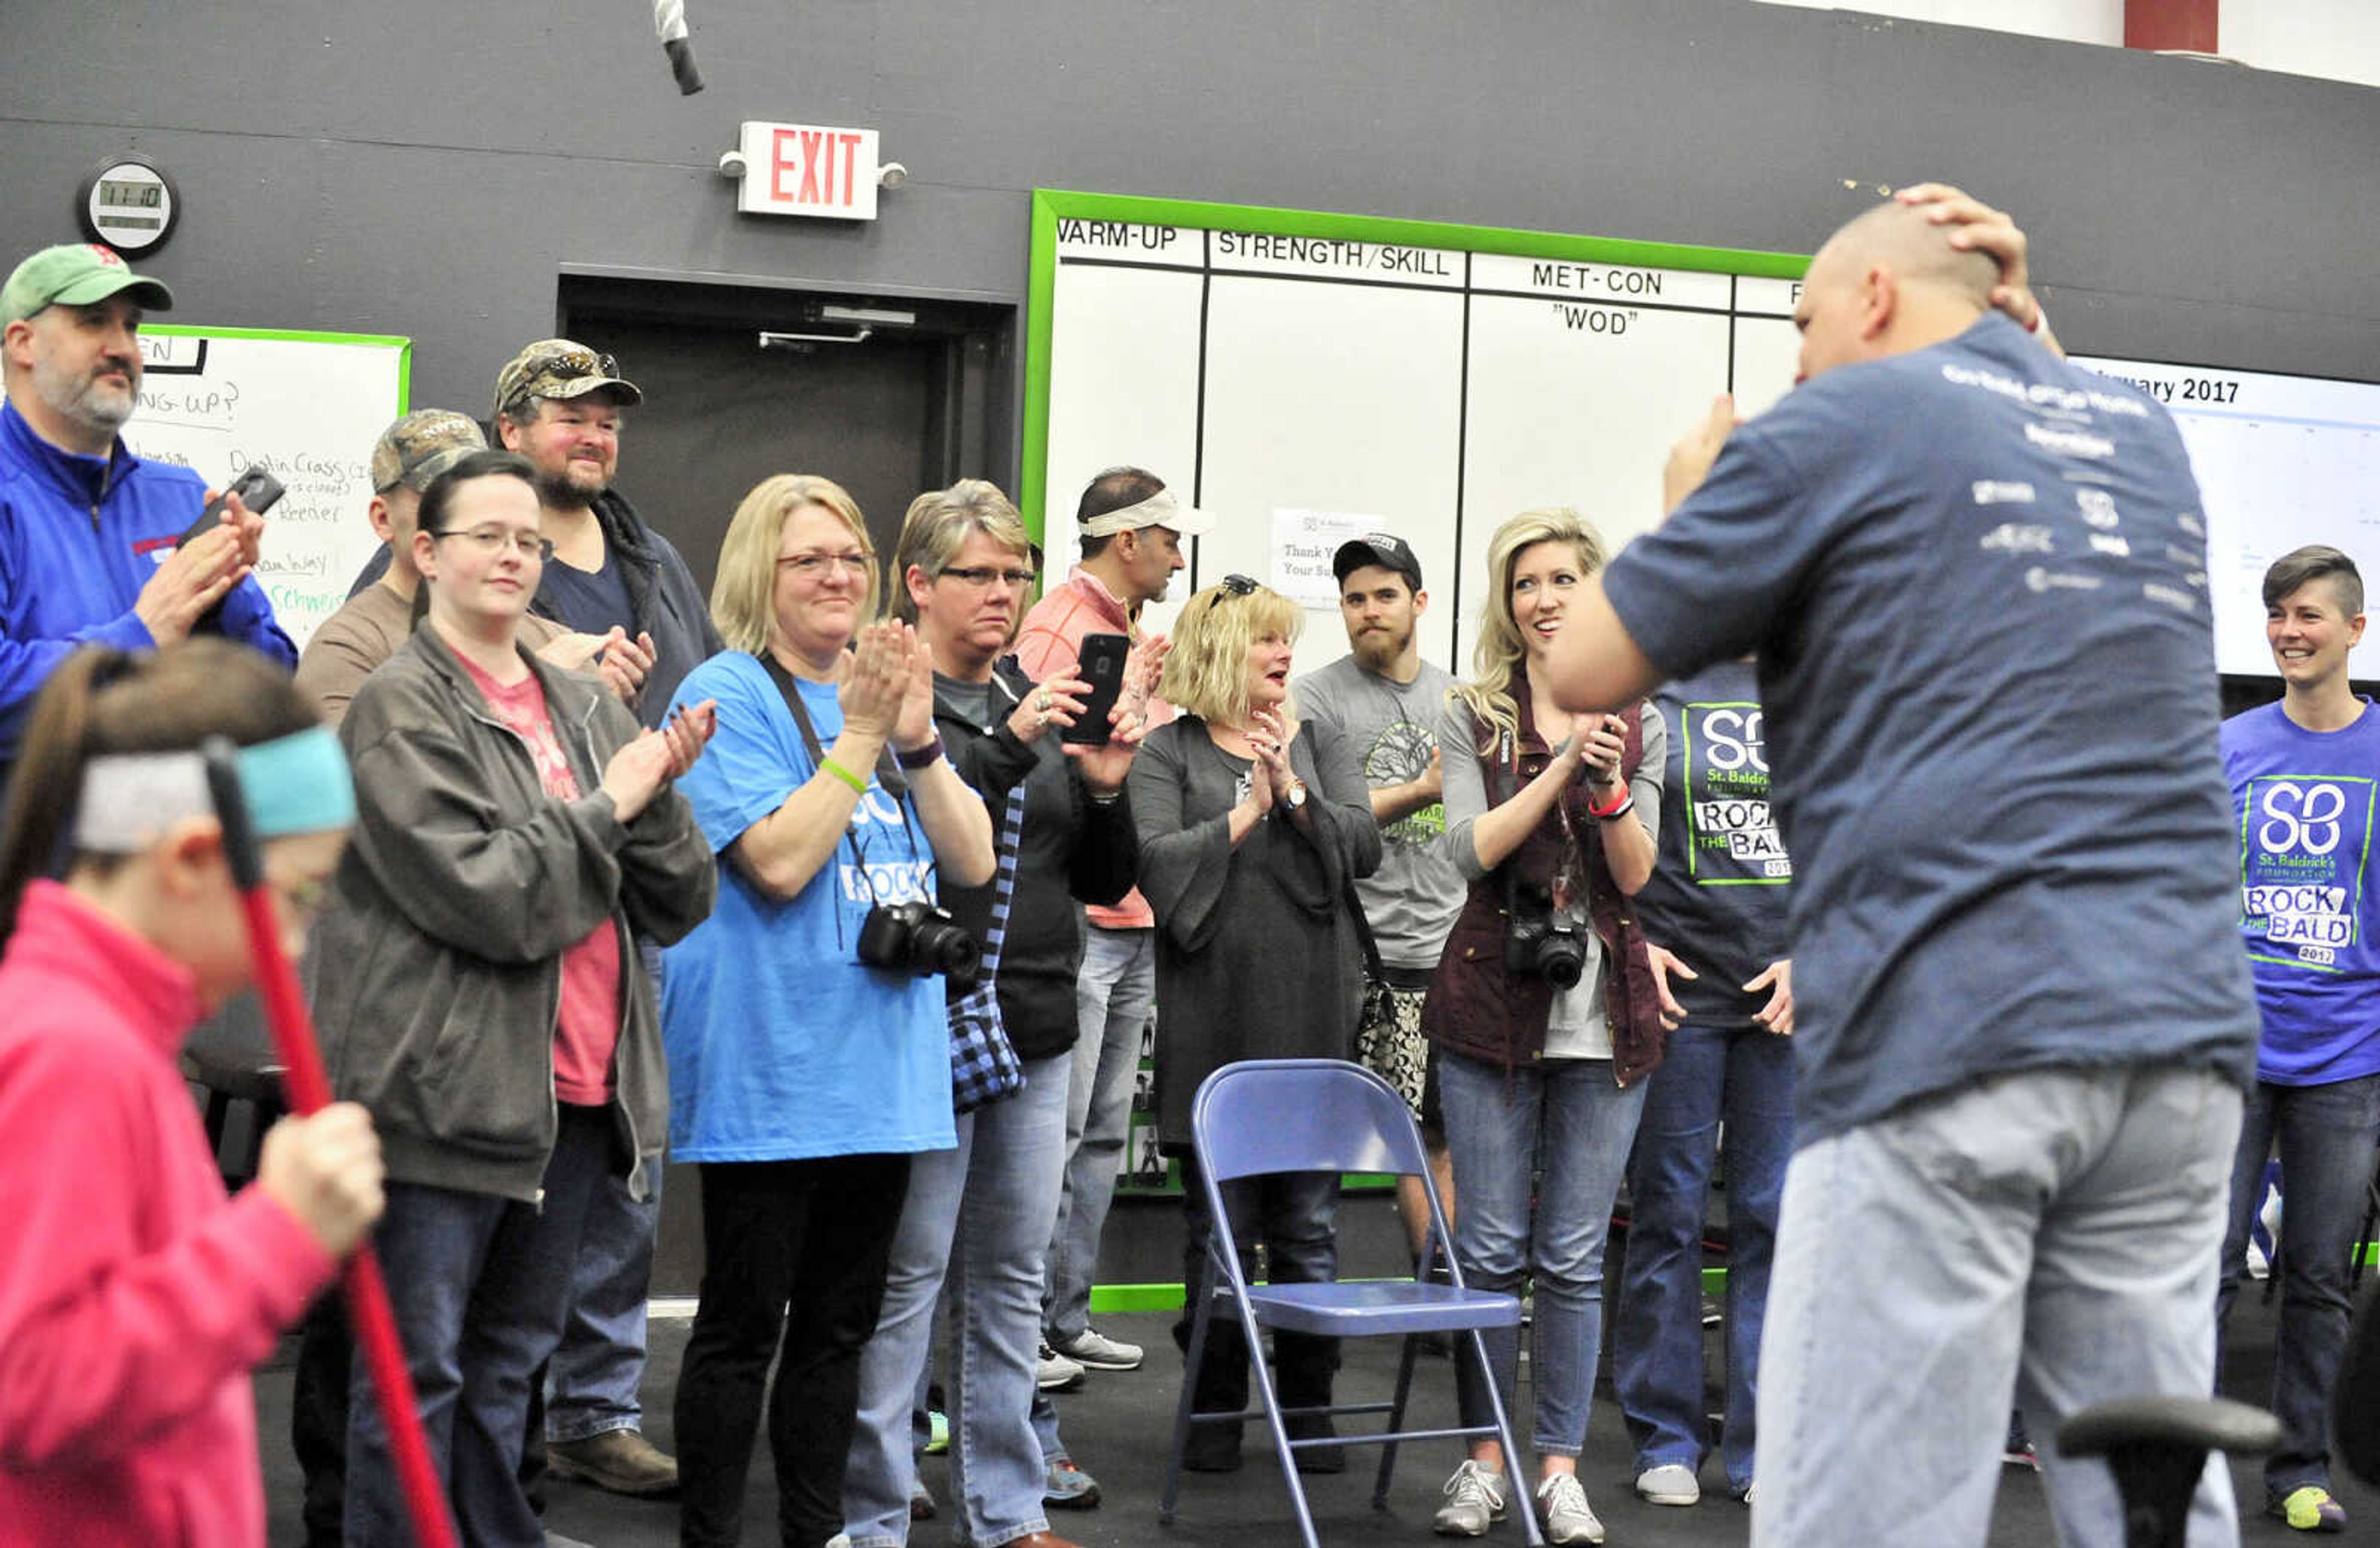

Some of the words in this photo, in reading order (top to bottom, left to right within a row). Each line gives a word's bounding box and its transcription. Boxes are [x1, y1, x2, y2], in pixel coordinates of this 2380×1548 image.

[771, 128, 862, 207] EXIT
[1219, 231, 1450, 276] STRENGTH/SKILL
[1533, 264, 1662, 295] MET-CON
[1553, 304, 1638, 335] "WOD"
[2182, 379, 2239, 403] 2017
[1285, 544, 1322, 559] Thank
[1284, 563, 1313, 577] Your
[1700, 836, 1727, 848] THE
[2248, 887, 2334, 914] ROCK
[2270, 917, 2348, 943] BALD
[2301, 948, 2332, 962] 2017
